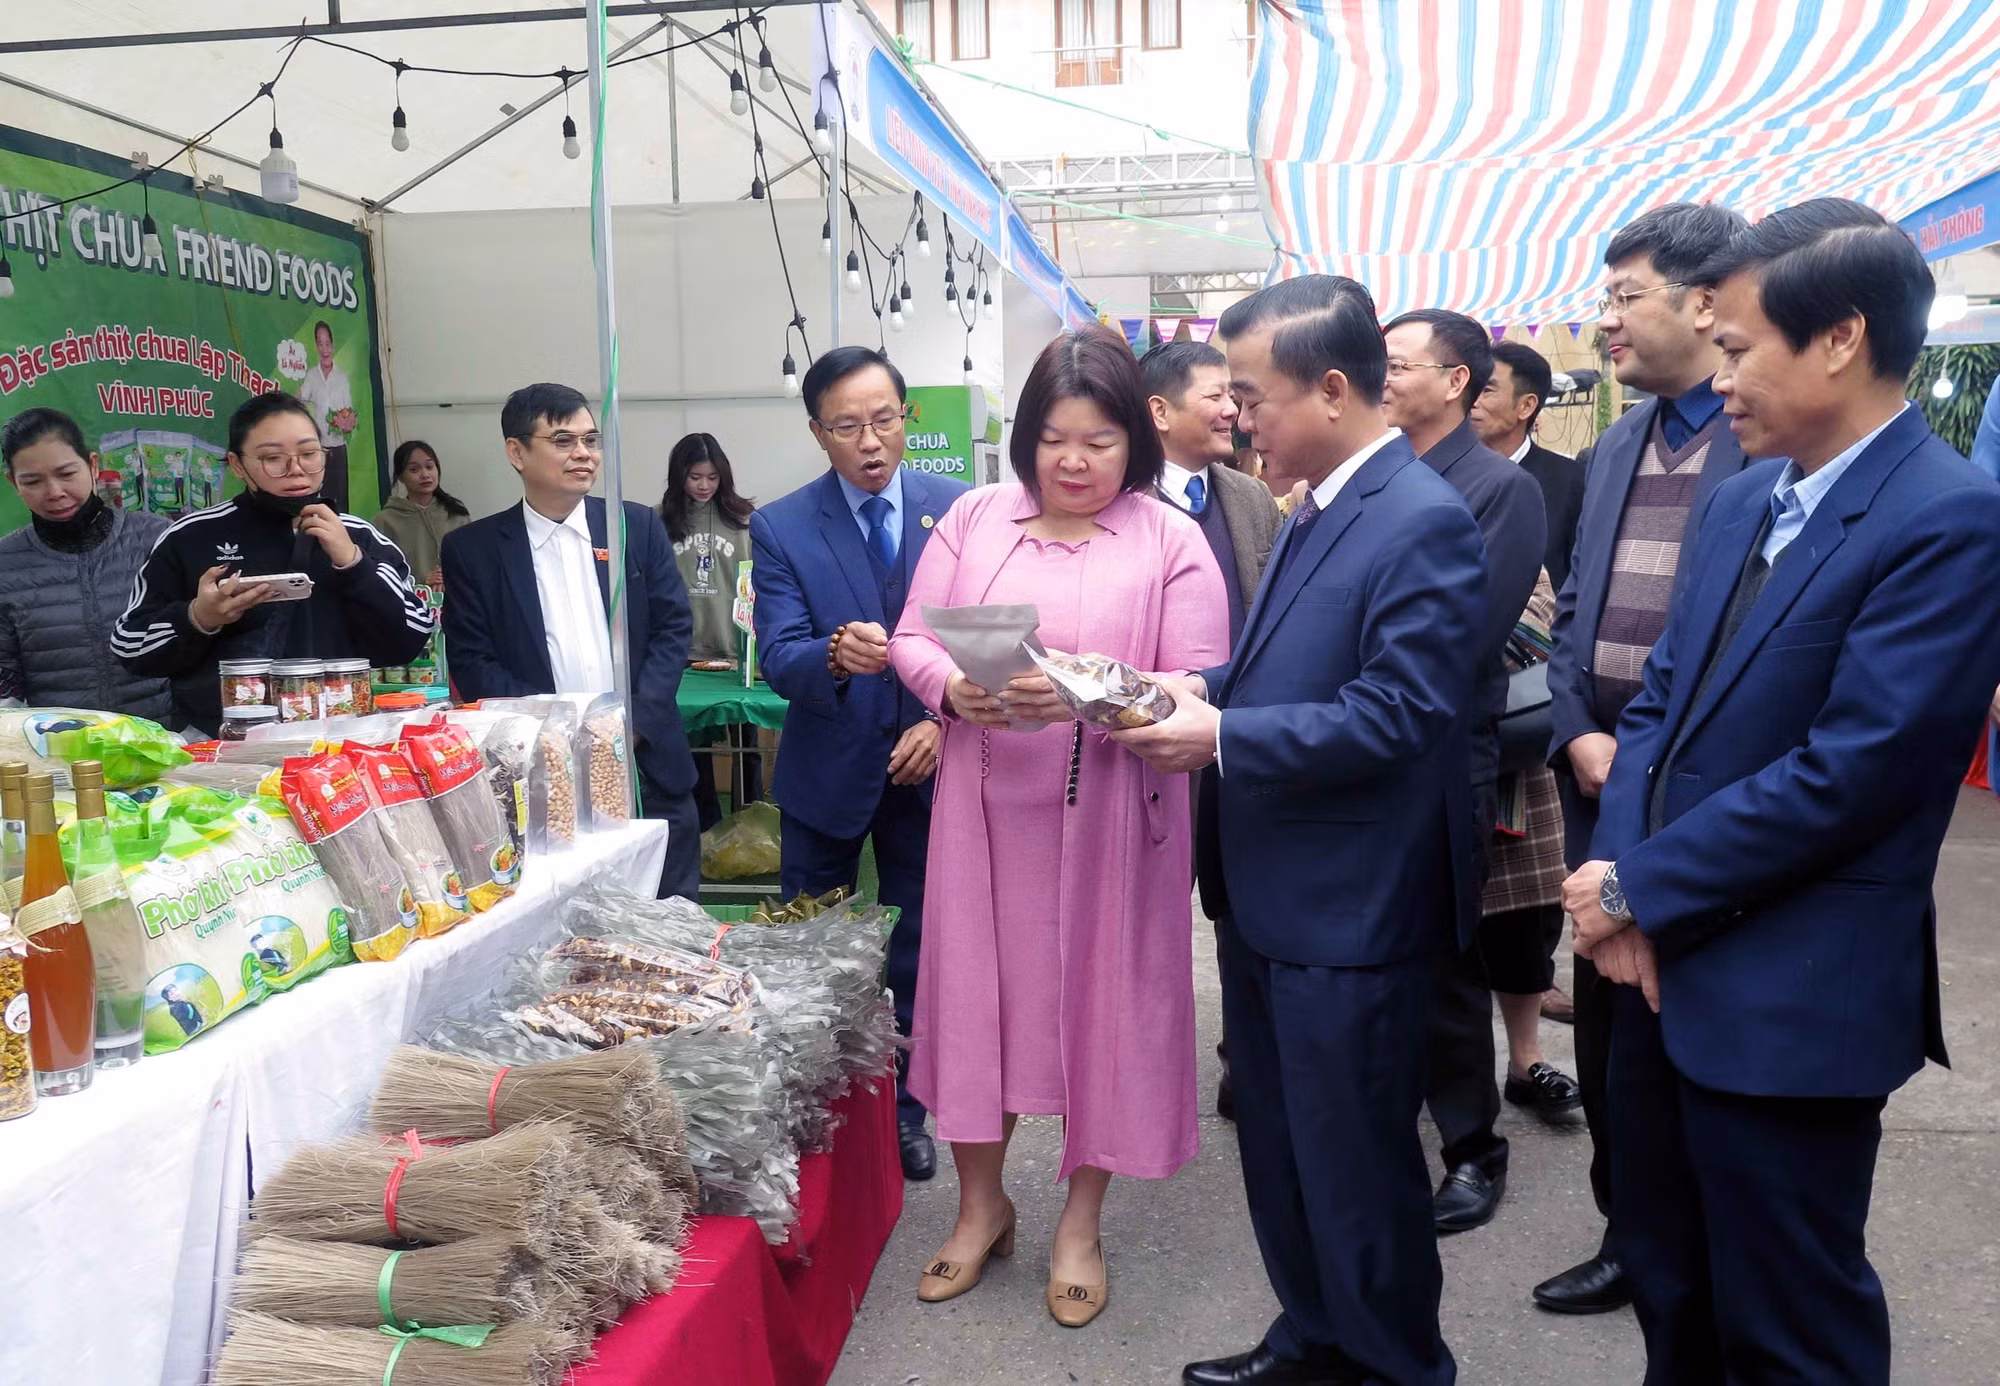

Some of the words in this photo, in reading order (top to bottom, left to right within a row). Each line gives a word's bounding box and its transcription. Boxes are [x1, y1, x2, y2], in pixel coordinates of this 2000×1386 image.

[1920, 214, 1940, 253] HẢI
[1941, 204, 1984, 243] PHÒNG
[173, 224, 273, 293] FRIEND
[276, 249, 359, 310] FOODS
[0, 345, 48, 395] Đặc
[49, 328, 94, 370] sản
[94, 324, 134, 366] thịt
[135, 326, 191, 366] chua
[190, 334, 226, 382] Lập
[97, 380, 156, 415] VĨNH
[159, 384, 215, 418] PHÚC
[906, 433, 950, 450] CHUA
[912, 457, 966, 473] FOODS
[220, 843, 285, 895] Phở
[137, 882, 202, 939] Phở
